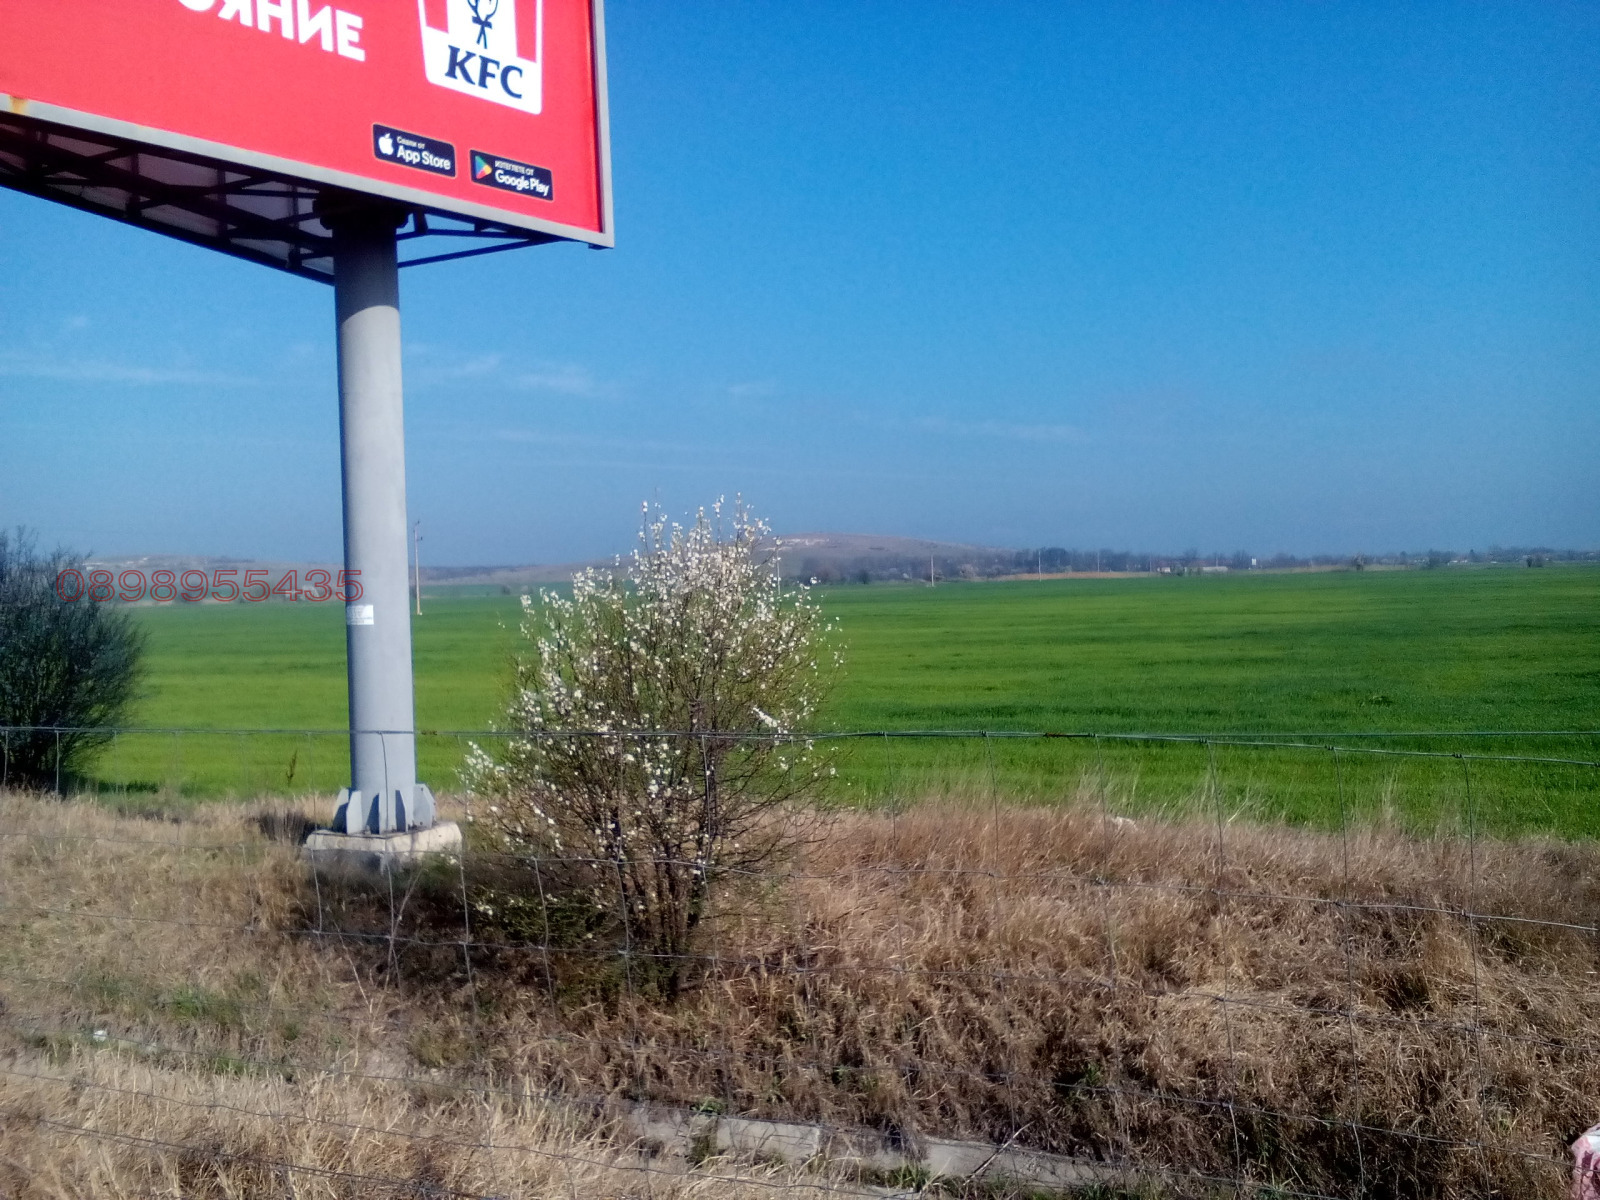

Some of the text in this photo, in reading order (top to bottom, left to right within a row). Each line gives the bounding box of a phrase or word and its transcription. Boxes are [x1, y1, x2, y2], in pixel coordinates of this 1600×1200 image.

[178, 0, 366, 62] ЯНИЕ
[445, 44, 523, 99] KFC
[397, 145, 451, 170] App Store
[495, 169, 550, 197] Google Play
